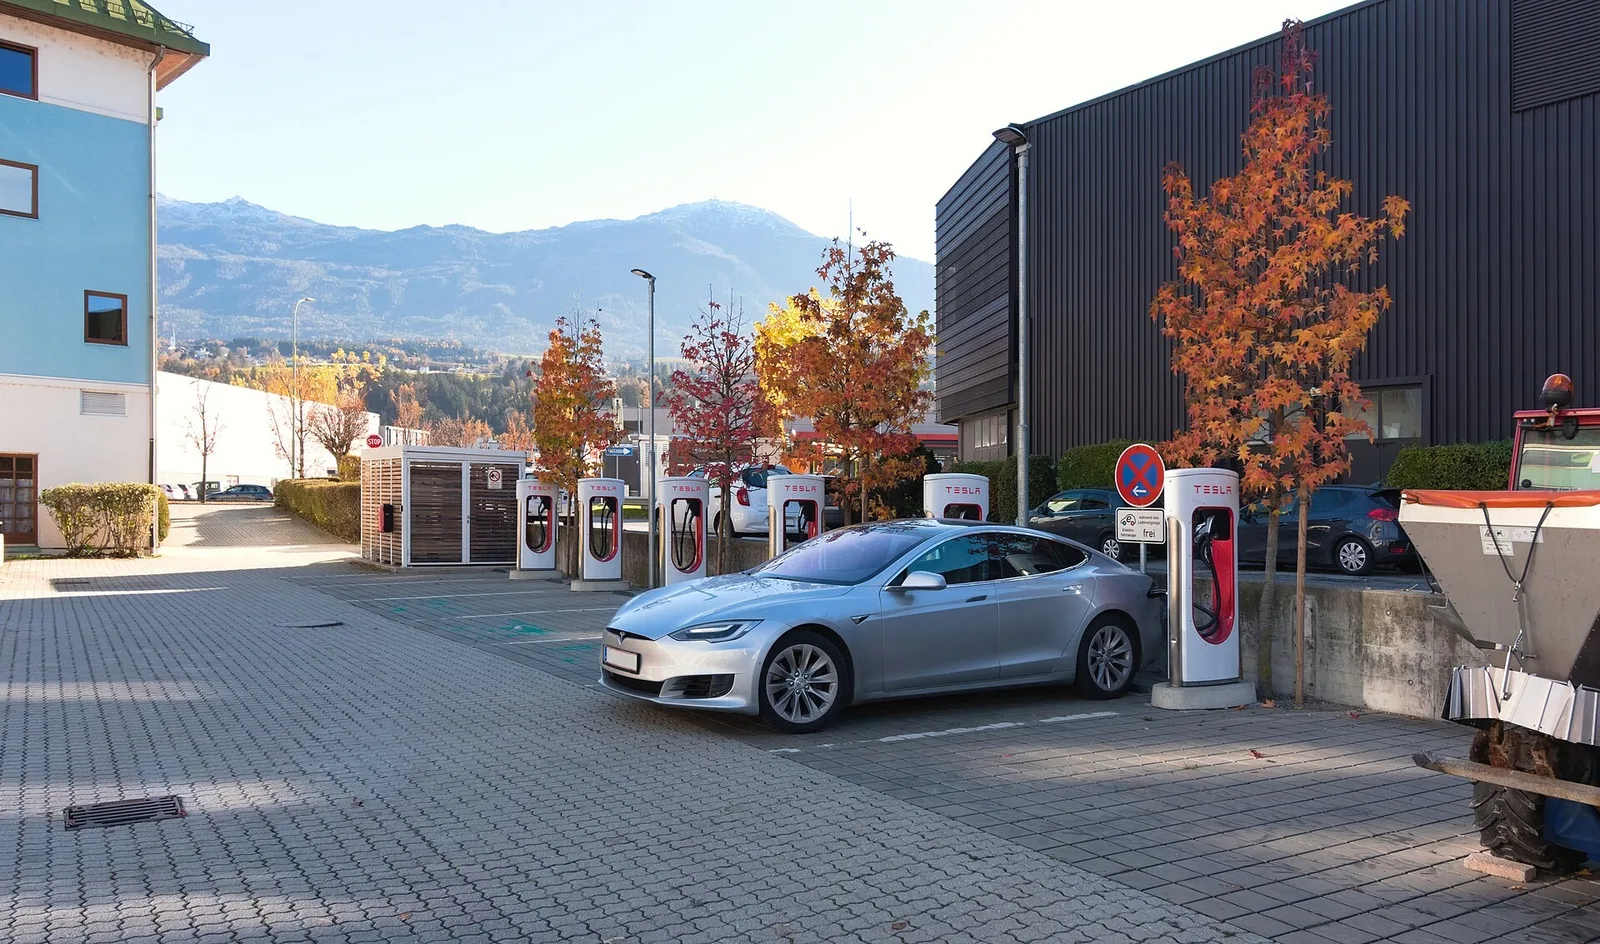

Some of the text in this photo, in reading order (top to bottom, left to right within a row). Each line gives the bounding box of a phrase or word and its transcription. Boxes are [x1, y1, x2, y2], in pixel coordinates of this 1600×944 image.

[946, 486, 981, 495] TESLA
[1194, 485, 1232, 494] TESLA
[1143, 529, 1156, 538] frei
